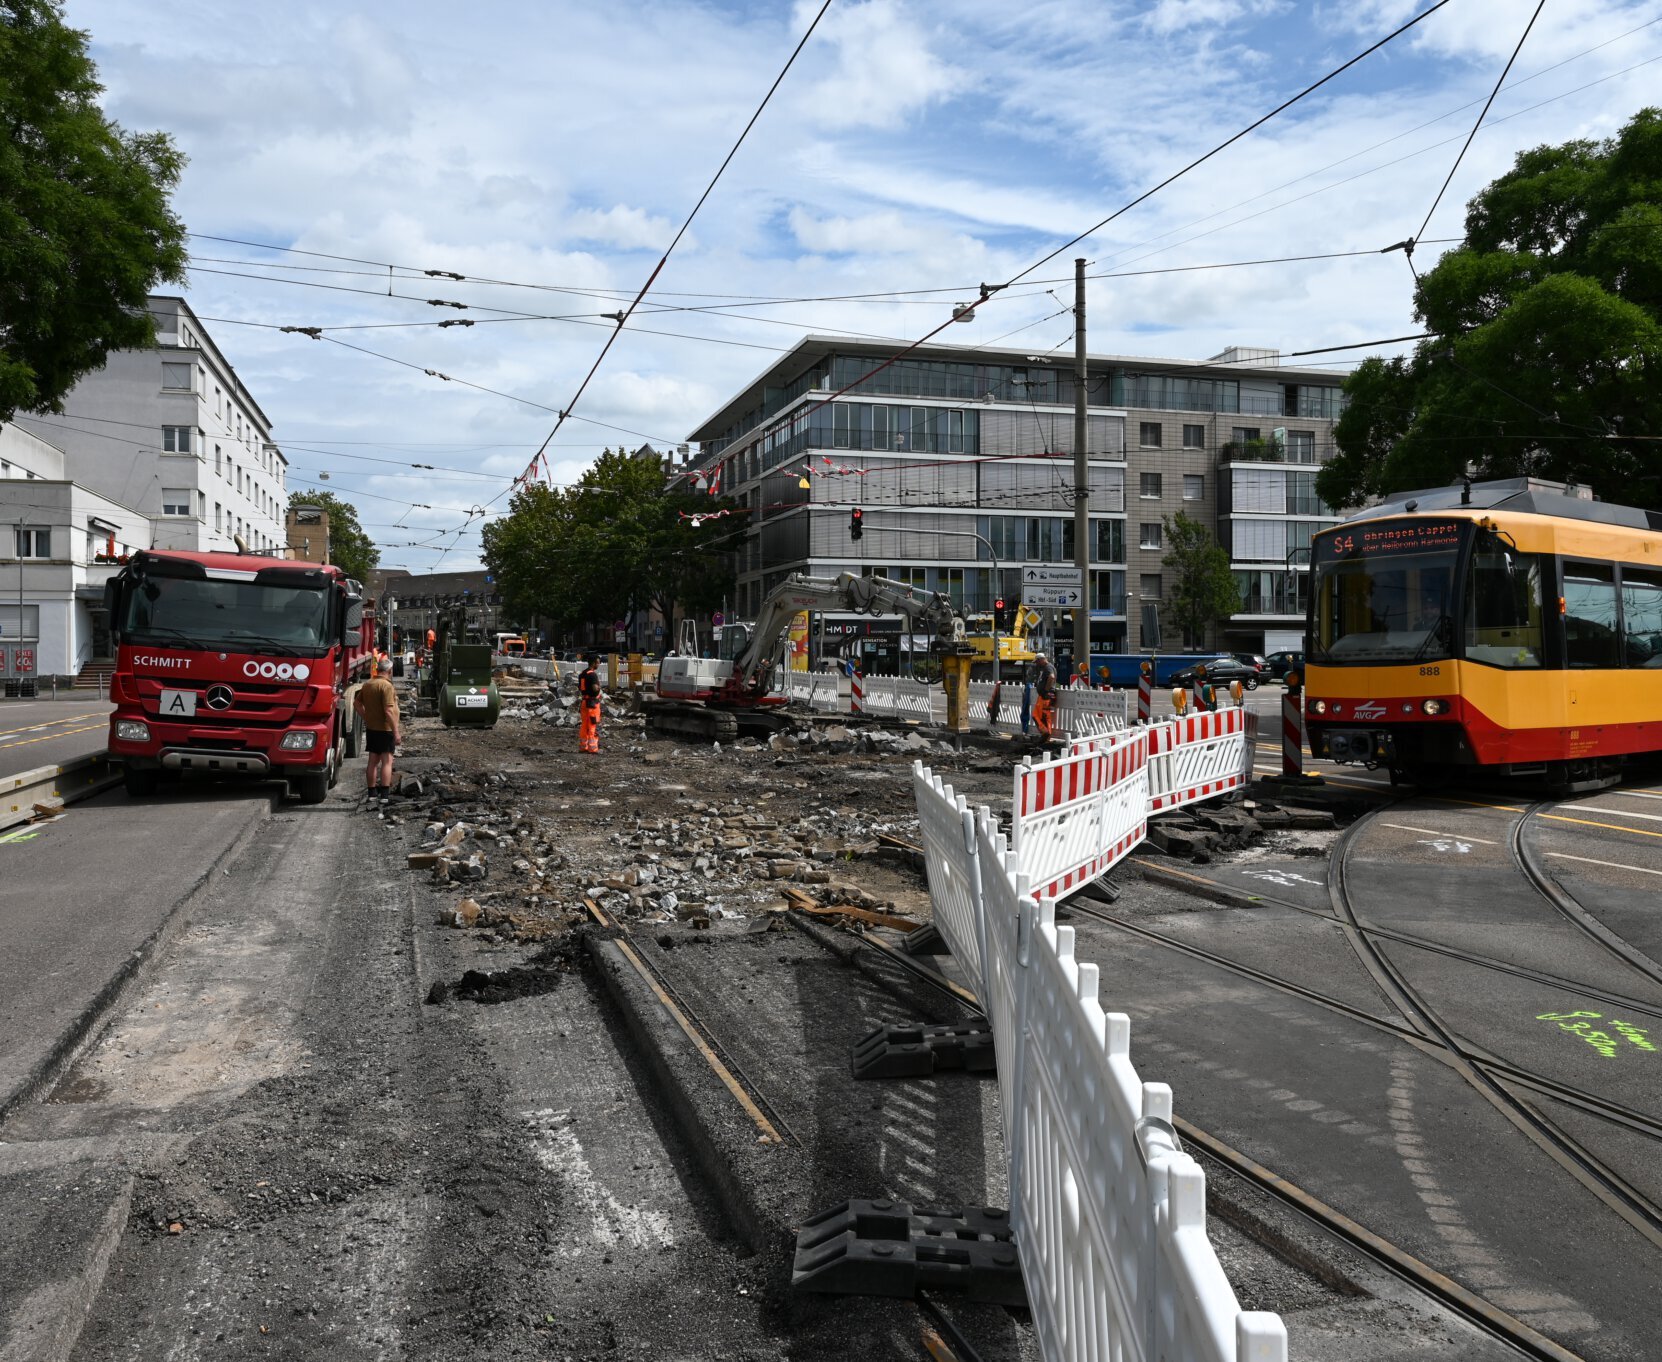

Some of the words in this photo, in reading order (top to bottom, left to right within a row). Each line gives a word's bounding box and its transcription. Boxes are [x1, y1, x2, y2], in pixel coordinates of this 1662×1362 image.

[1334, 535, 1354, 553] S4
[133, 655, 192, 669] SCHMITT
[1419, 666, 1440, 676] 888
[169, 693, 186, 713] A
[1353, 711, 1372, 720] AVG
